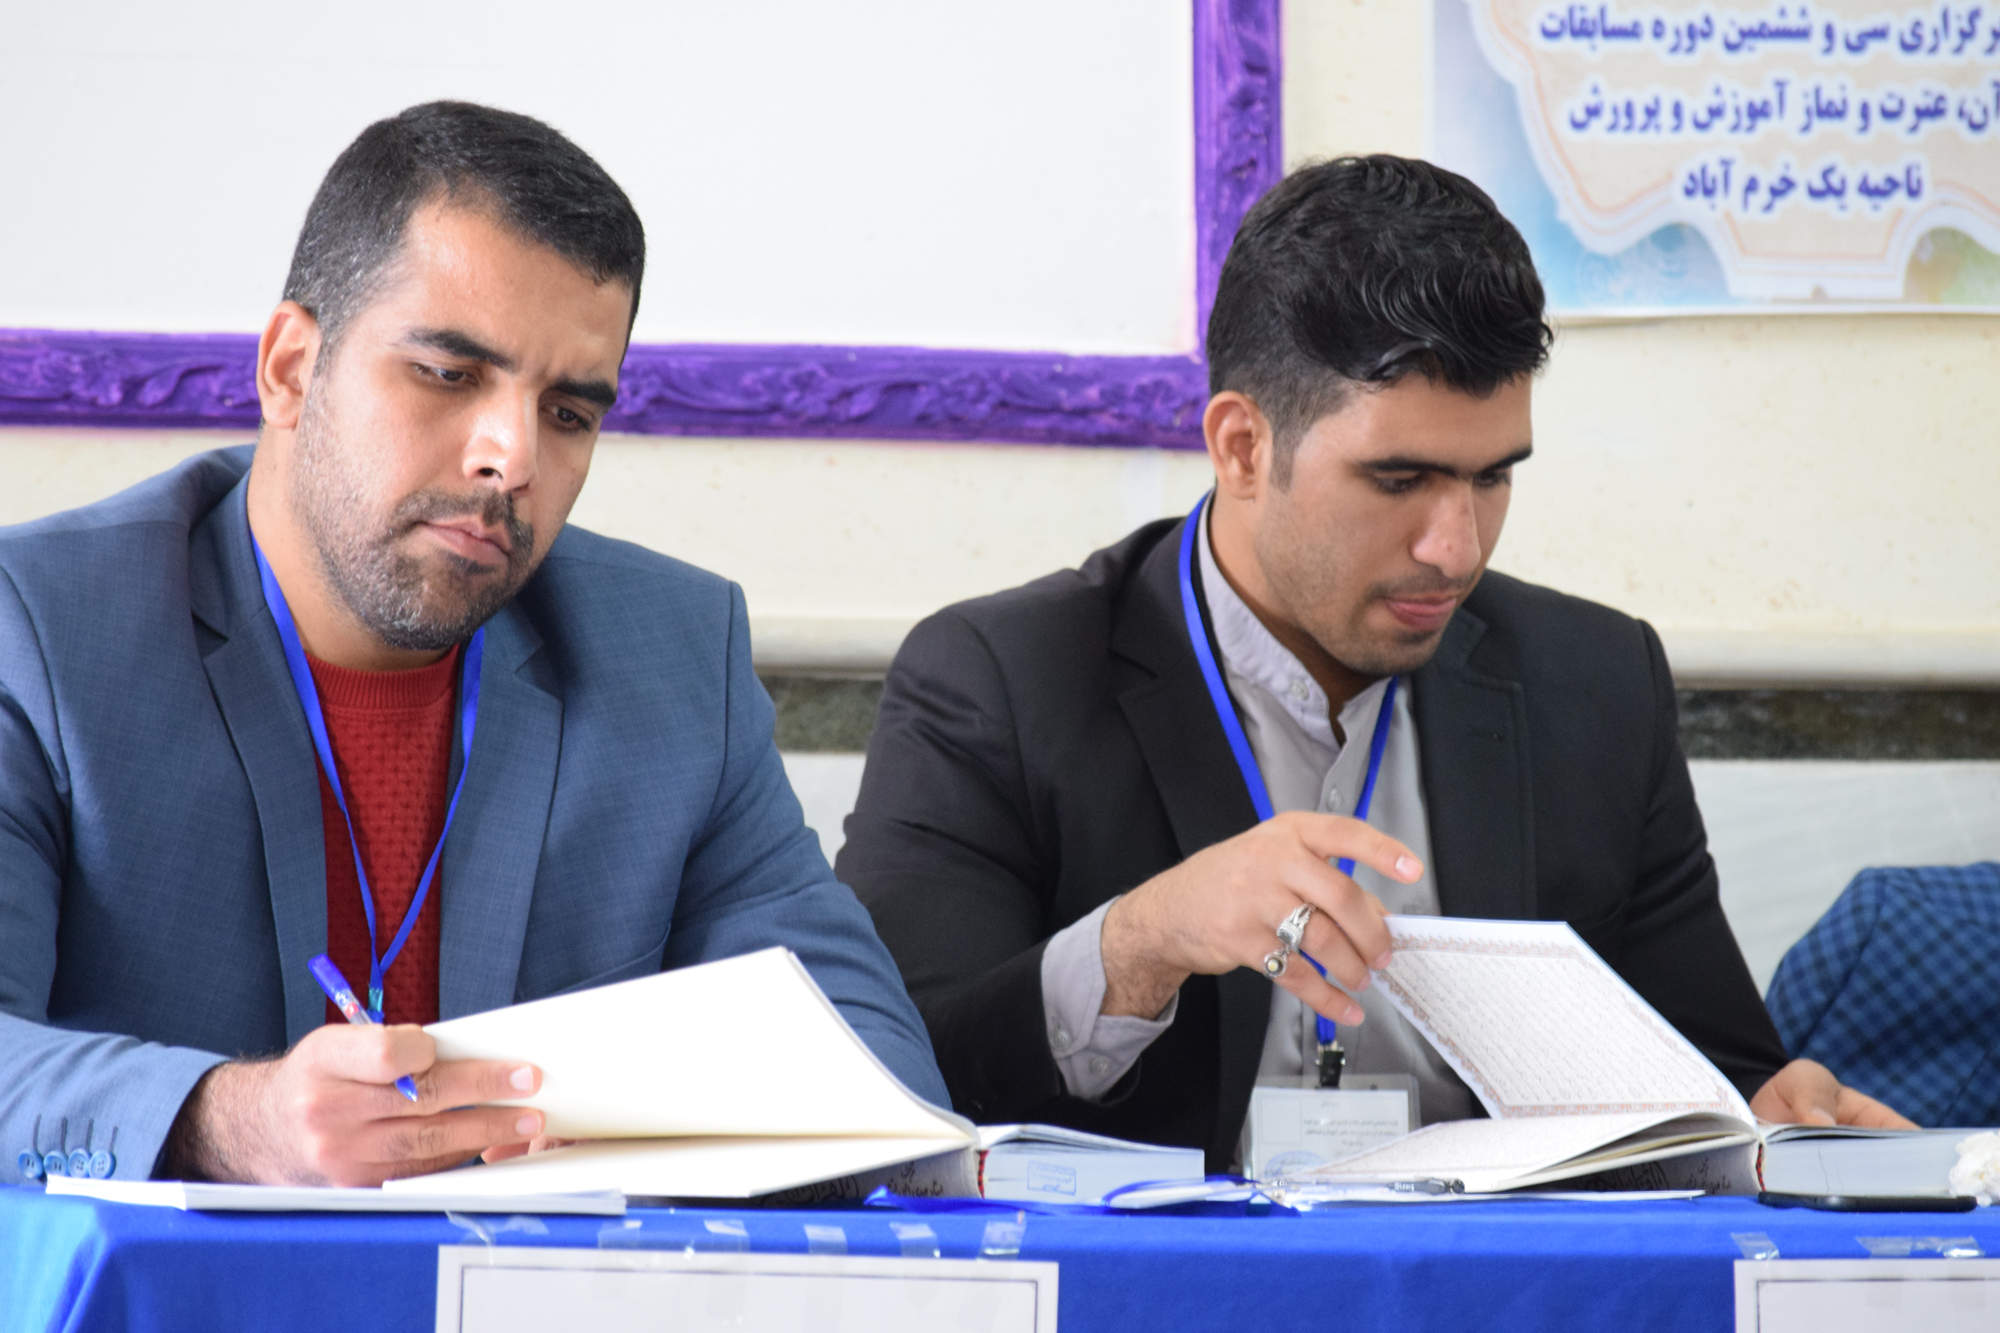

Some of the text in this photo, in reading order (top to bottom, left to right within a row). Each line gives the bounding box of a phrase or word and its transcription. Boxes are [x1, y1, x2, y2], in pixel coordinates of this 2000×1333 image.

[1540, 5, 1643, 51] مسابقات
[1652, 14, 1714, 54] دوره
[1723, 8, 1812, 55] ششمین
[1822, 22, 1835, 55] و
[1843, 23, 1890, 55] سی
[1570, 84, 1660, 134] پرورش
[1671, 100, 1683, 132] و
[1692, 79, 1786, 133] آموزش
[1800, 84, 1848, 133] نماز
[1858, 101, 1871, 133] و
[1879, 90, 1948, 134] عترت
[1684, 158, 1923, 213] ناحیه یک خرم آباد
